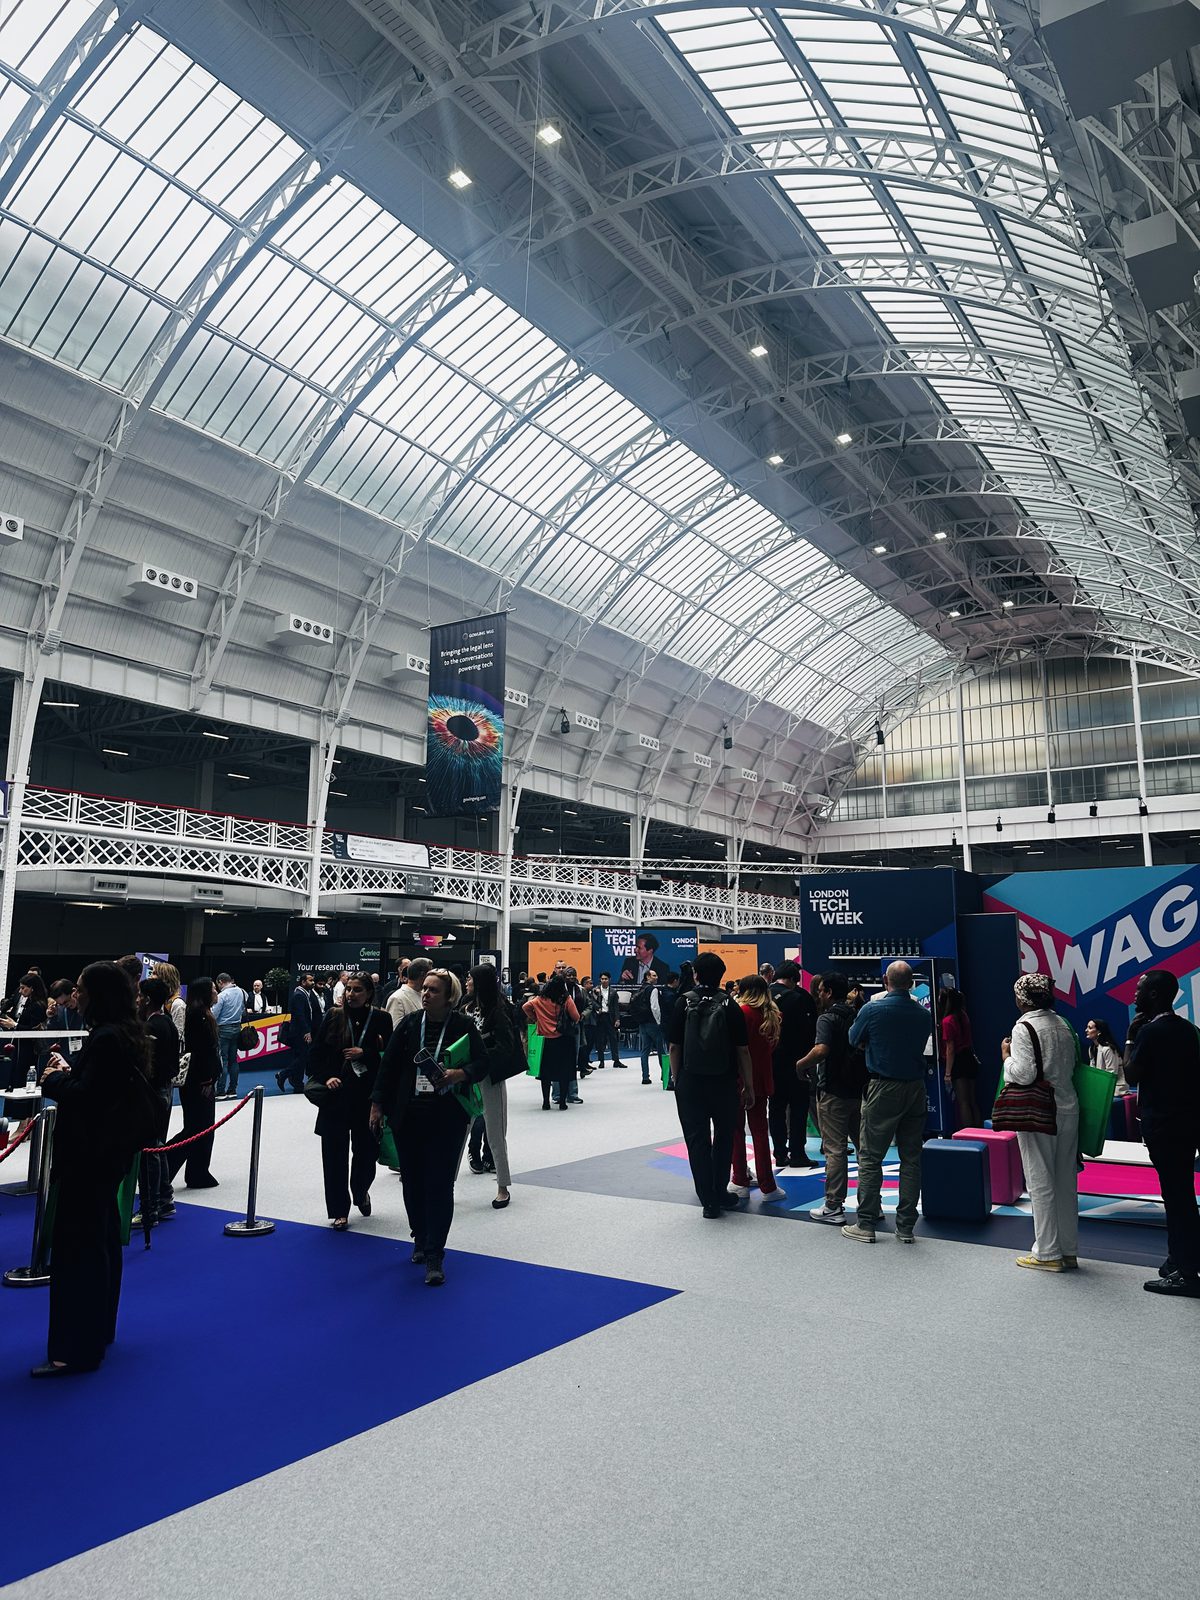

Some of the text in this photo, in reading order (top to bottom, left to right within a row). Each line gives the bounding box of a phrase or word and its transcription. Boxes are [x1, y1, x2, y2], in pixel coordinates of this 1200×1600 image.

[440, 648, 461, 658] Bringing
[469, 643, 482, 653] legal
[459, 651, 494, 663] conversations
[458, 661, 493, 675] powering tech
[809, 889, 849, 898] LONDON
[809, 898, 850, 912] TECH
[820, 911, 864, 925] WEEK
[605, 934, 636, 945] TECH
[1018, 884, 1199, 995] SWAG
[296, 962, 360, 971] Your research isn't
